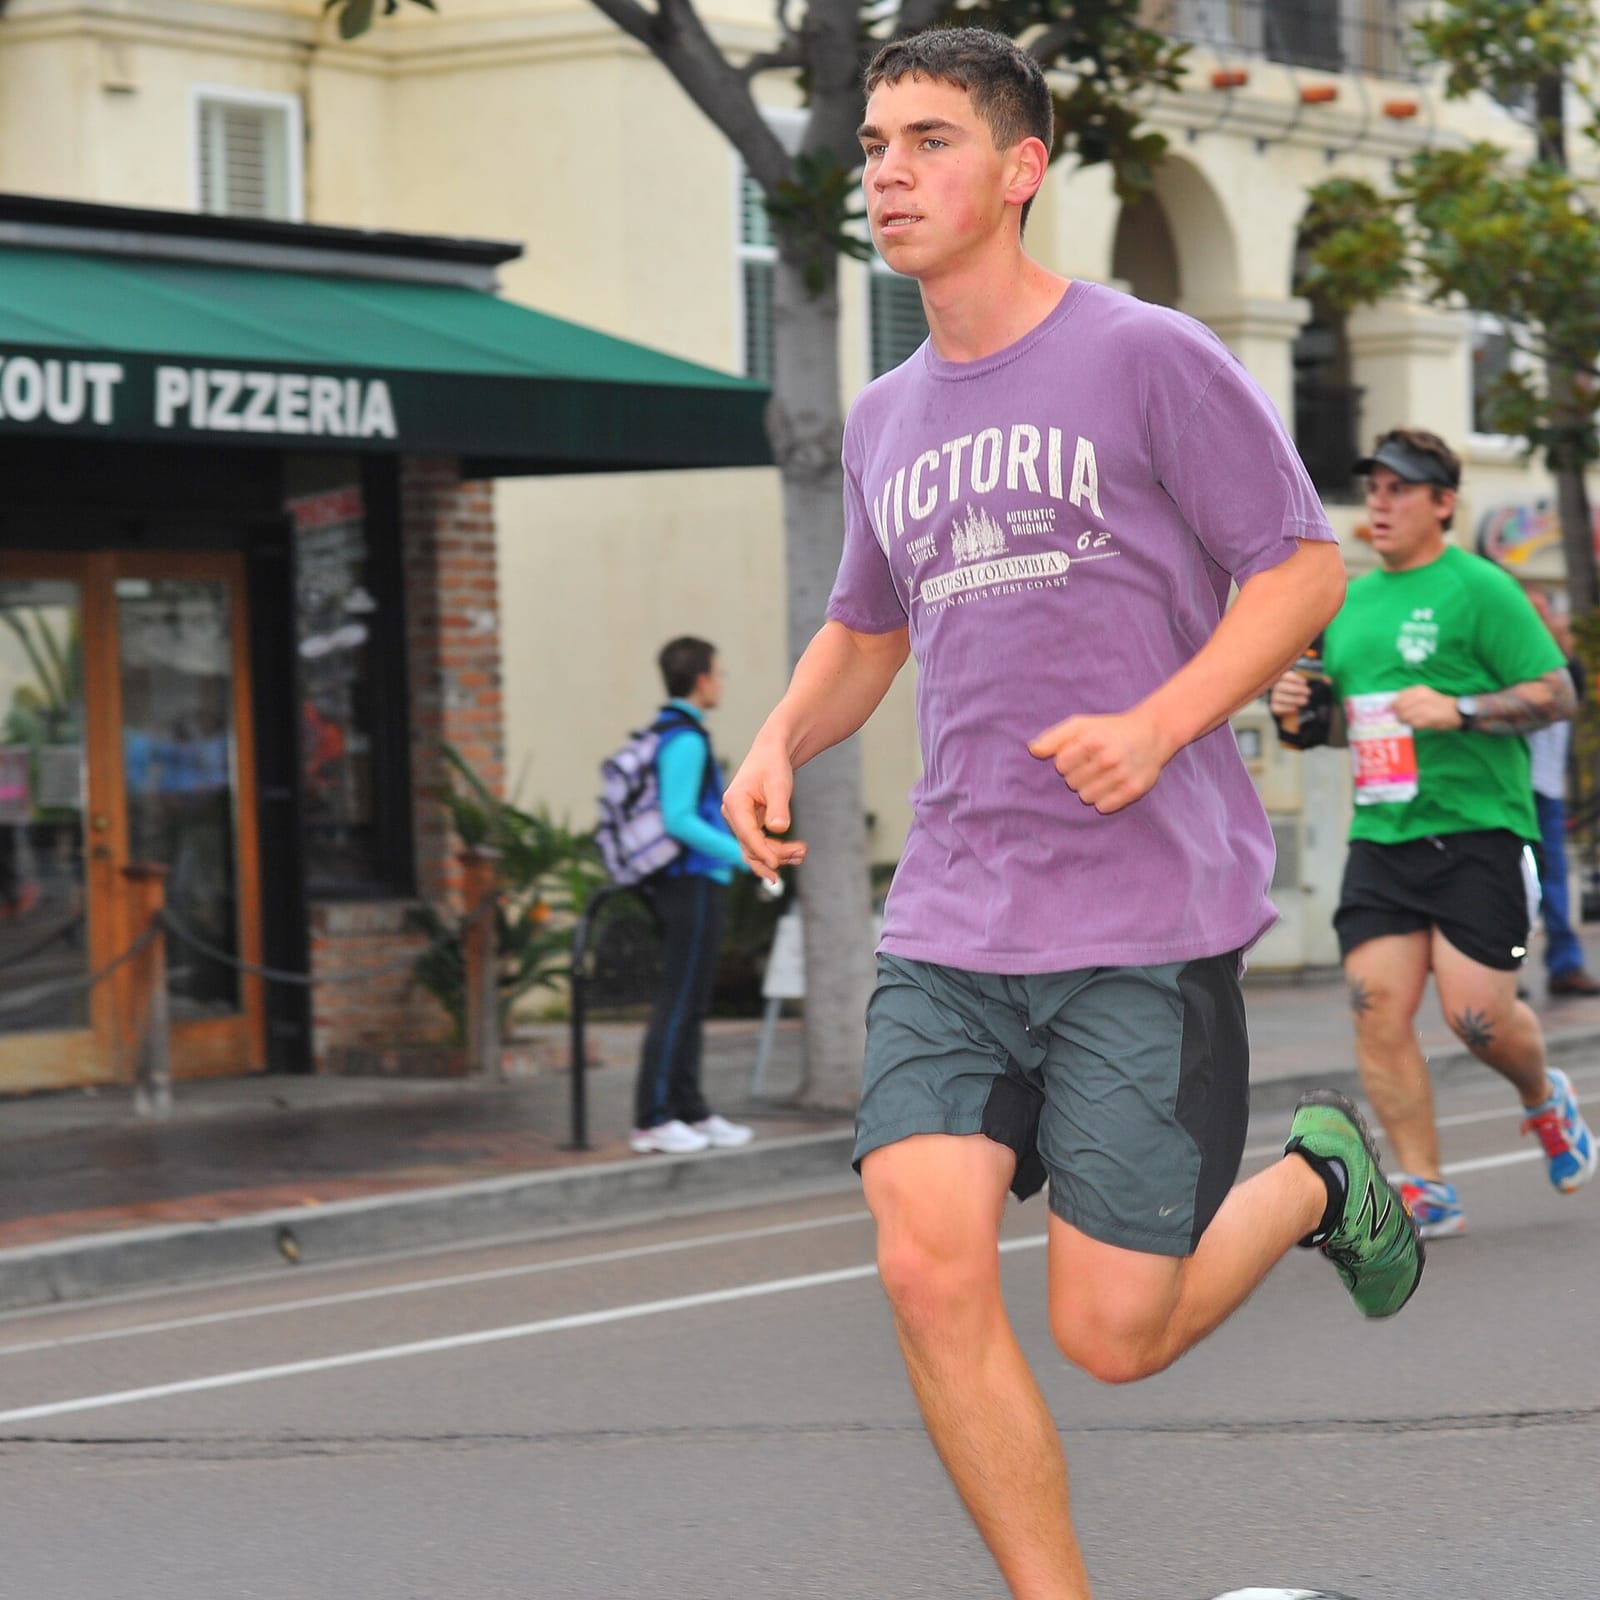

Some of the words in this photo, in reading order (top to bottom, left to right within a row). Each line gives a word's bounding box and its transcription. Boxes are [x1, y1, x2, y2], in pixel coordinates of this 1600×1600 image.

[0, 356, 124, 425] OUT
[155, 366, 398, 438] PIZZERIA
[873, 423, 1105, 555] VICTORIA
[1006, 507, 1056, 524] AUTHENTIC
[1011, 521, 1055, 536] ORIGINAL
[1076, 530, 1112, 551] 62
[977, 556, 1059, 582] COLUMBIA
[939, 589, 988, 613] CNADA'S
[992, 582, 1023, 598] WEST
[1027, 576, 1069, 590] COAST
